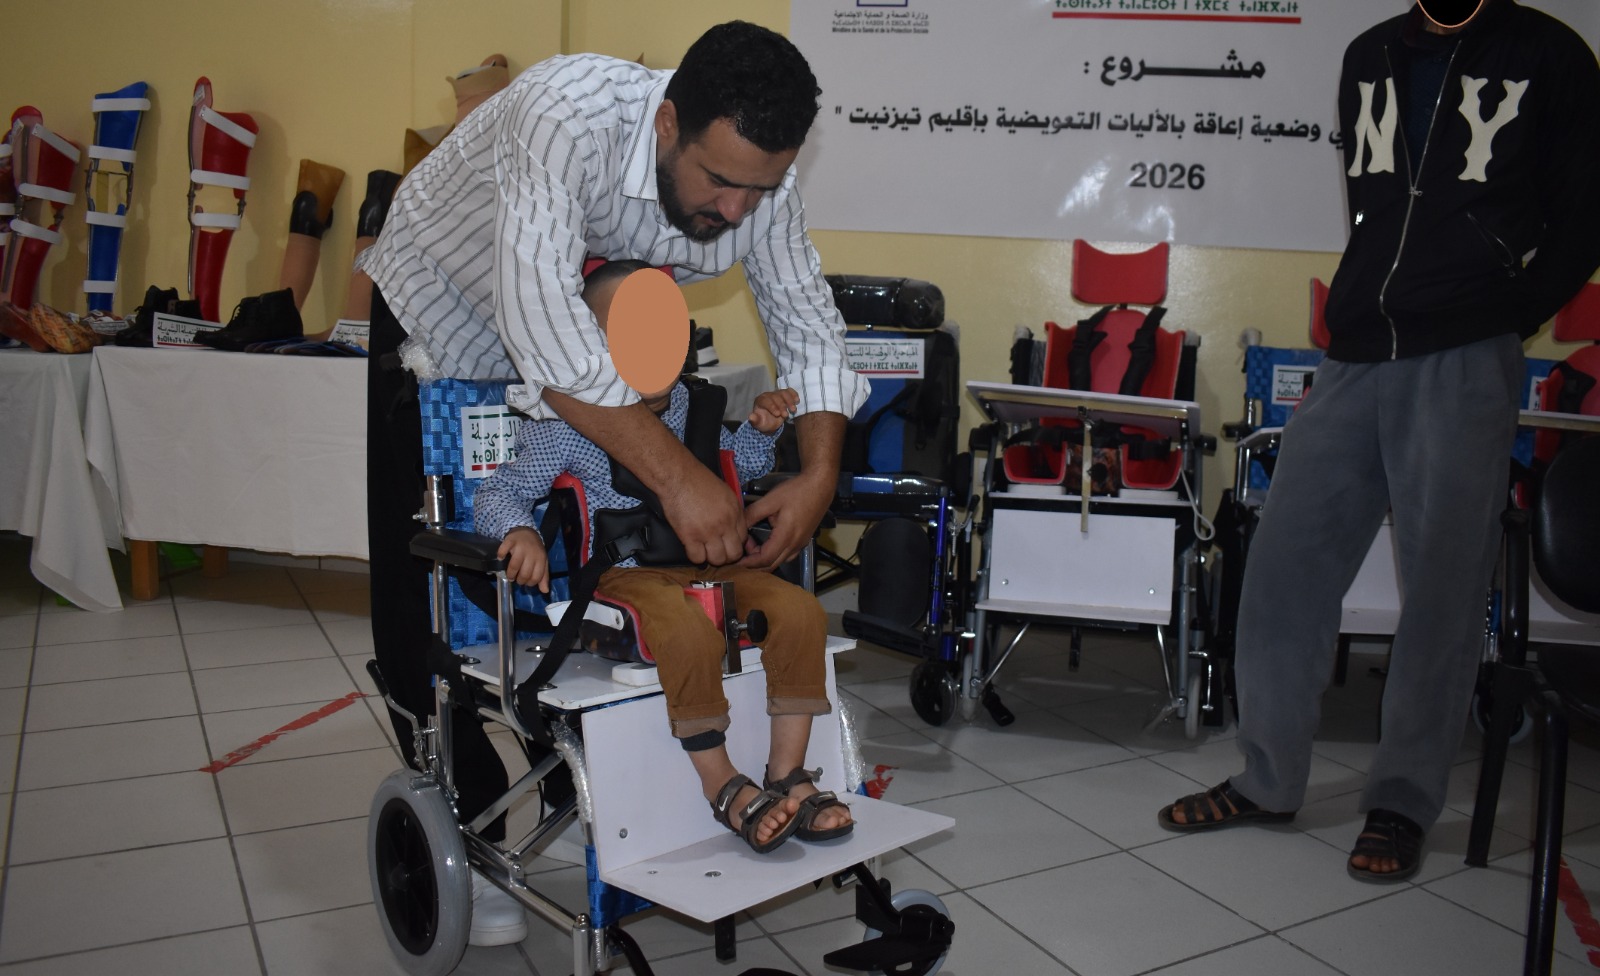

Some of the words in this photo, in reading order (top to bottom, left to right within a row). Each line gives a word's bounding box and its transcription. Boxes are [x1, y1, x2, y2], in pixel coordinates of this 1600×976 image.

[849, 105, 922, 132] تيزنيت
[928, 105, 988, 133] بإقليم
[996, 106, 1100, 135] التعويضية
[1193, 112, 1243, 140] إعاقة
[1250, 114, 1321, 142] وضعية
[1128, 161, 1206, 190] 2026
